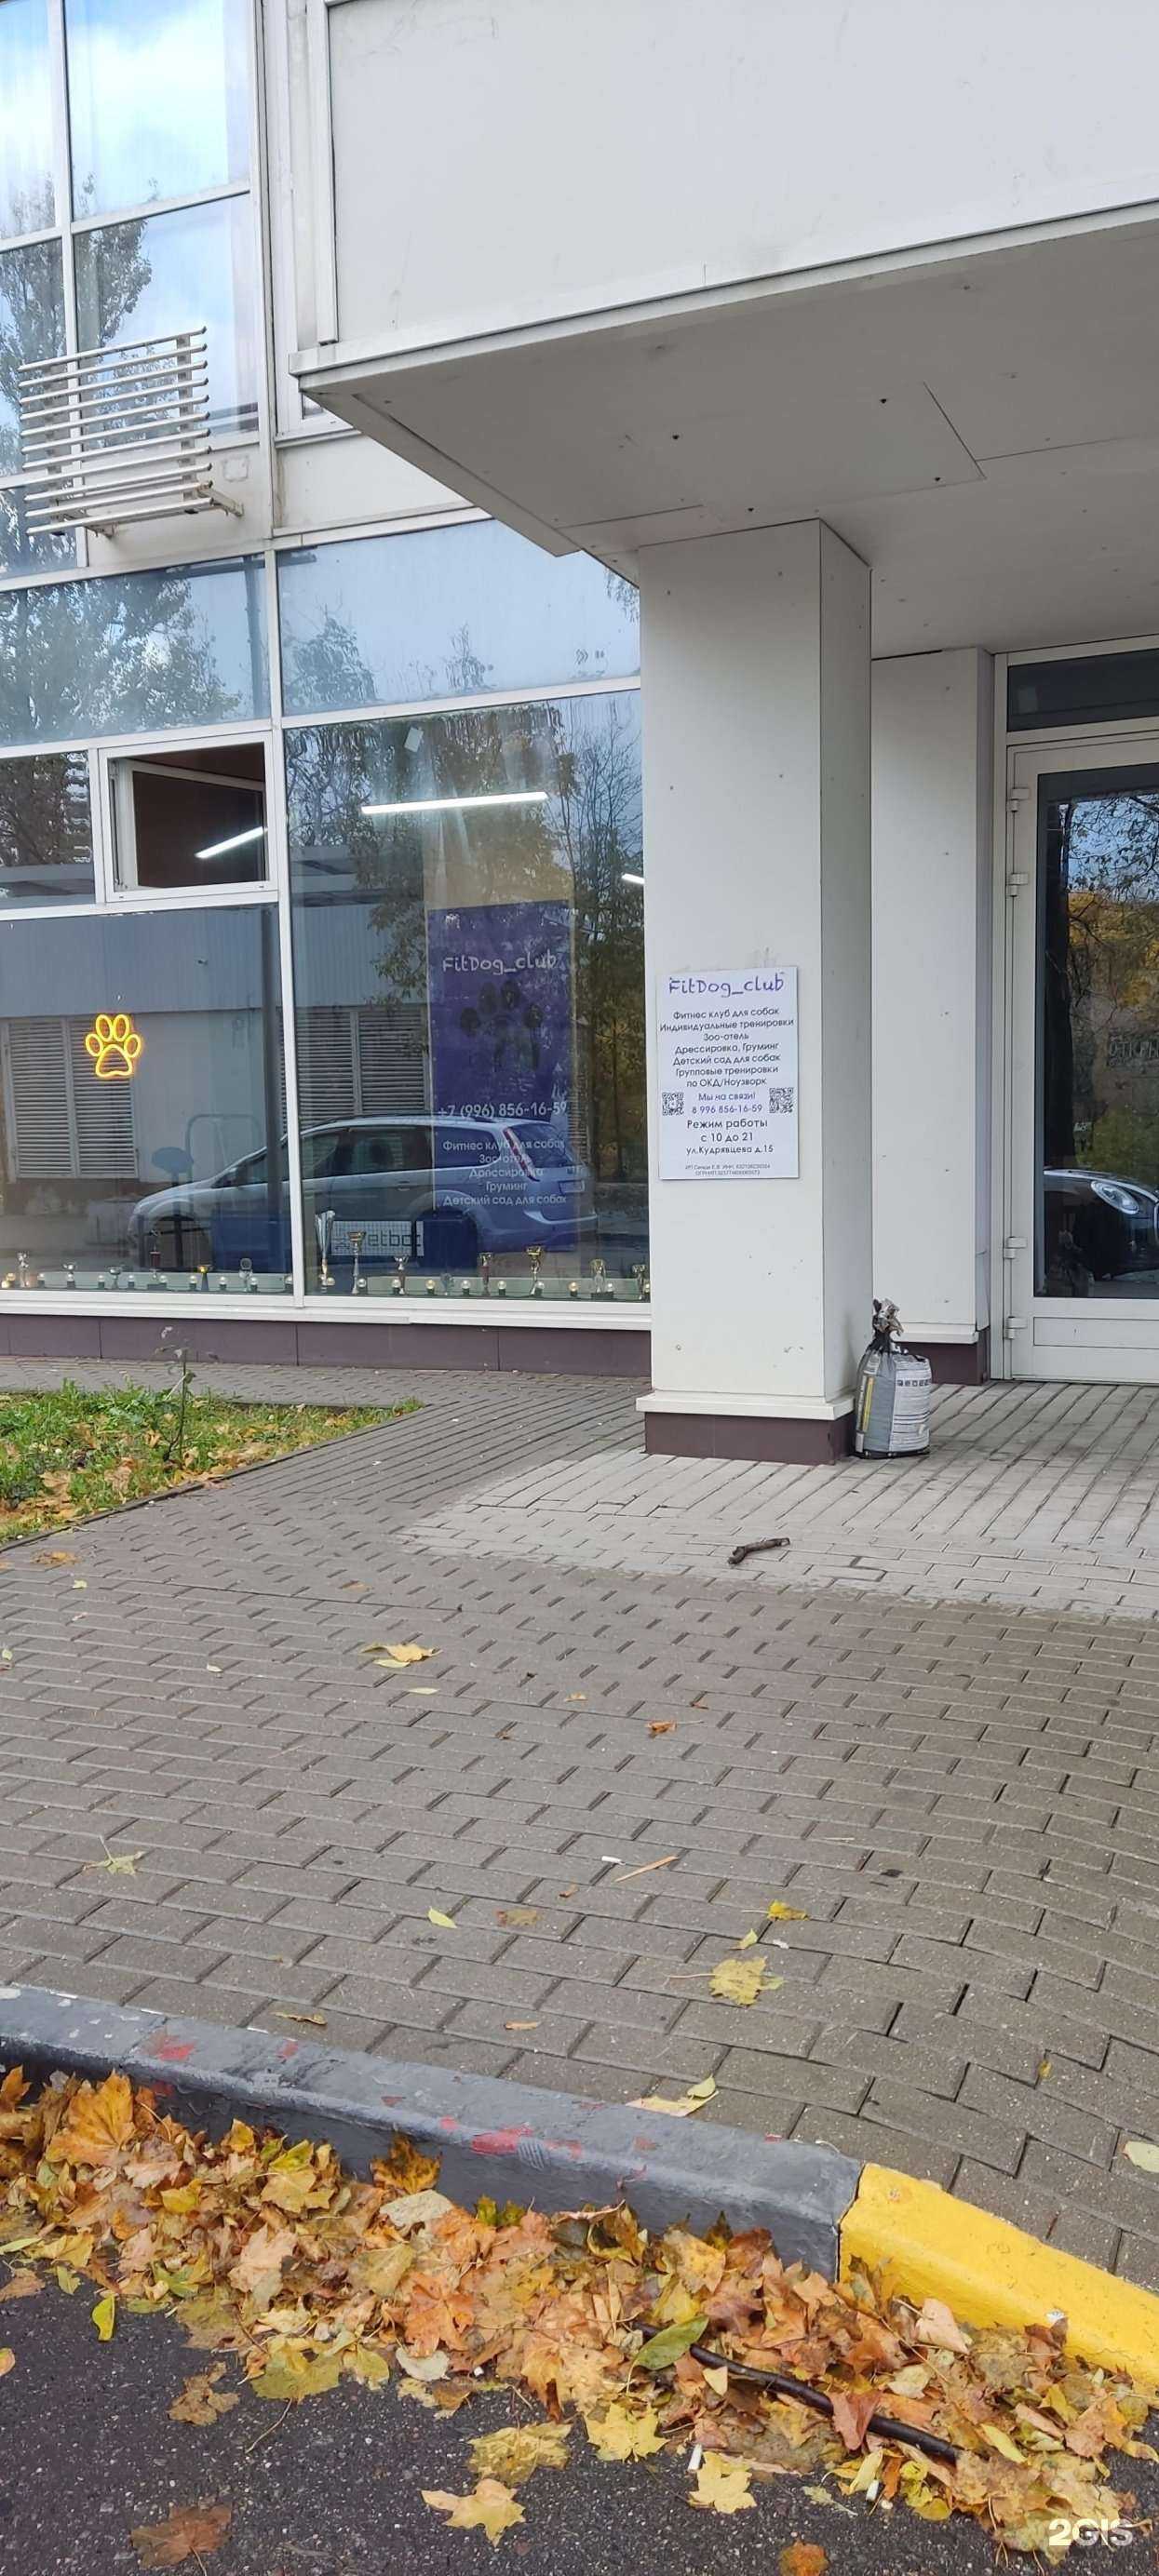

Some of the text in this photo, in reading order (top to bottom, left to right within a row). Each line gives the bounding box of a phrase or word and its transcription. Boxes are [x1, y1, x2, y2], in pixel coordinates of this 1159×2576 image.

[442, 948, 557, 975] FitDog_club
[669, 973, 784, 998] FitDog_club
[673, 1007, 779, 1020] Фитнес клуб для собак
[659, 1019, 794, 1032] Индивидуальные тренировки
[703, 1033, 749, 1041] Зоо-отель
[675, 1042, 779, 1055] Дрессировка, Груминг
[672, 1055, 712, 1067] Детский
[713, 1056, 731, 1065] сад
[751, 1053, 781, 1062] собак
[676, 1066, 779, 1078] Групповые тренировки
[686, 1080, 697, 1088] по
[698, 1093, 713, 1101] Мы
[728, 1092, 756, 1100] связи!
[438, 1101, 567, 1119] +7 (996) 856-16-59
[699, 1105, 716, 1114] 996
[718, 1104, 762, 1113] 856-16-59
[687, 1119, 768, 1130] Режим работы
[700, 1132, 753, 1143] с 10 до 21
[442, 1140, 484, 1151] Фитнес
[534, 1138, 565, 1149] собак
[754, 1145, 774, 1154] д.15
[486, 1182, 528, 1193] Груминг
[443, 1194, 566, 1207] Детский сад для собак
